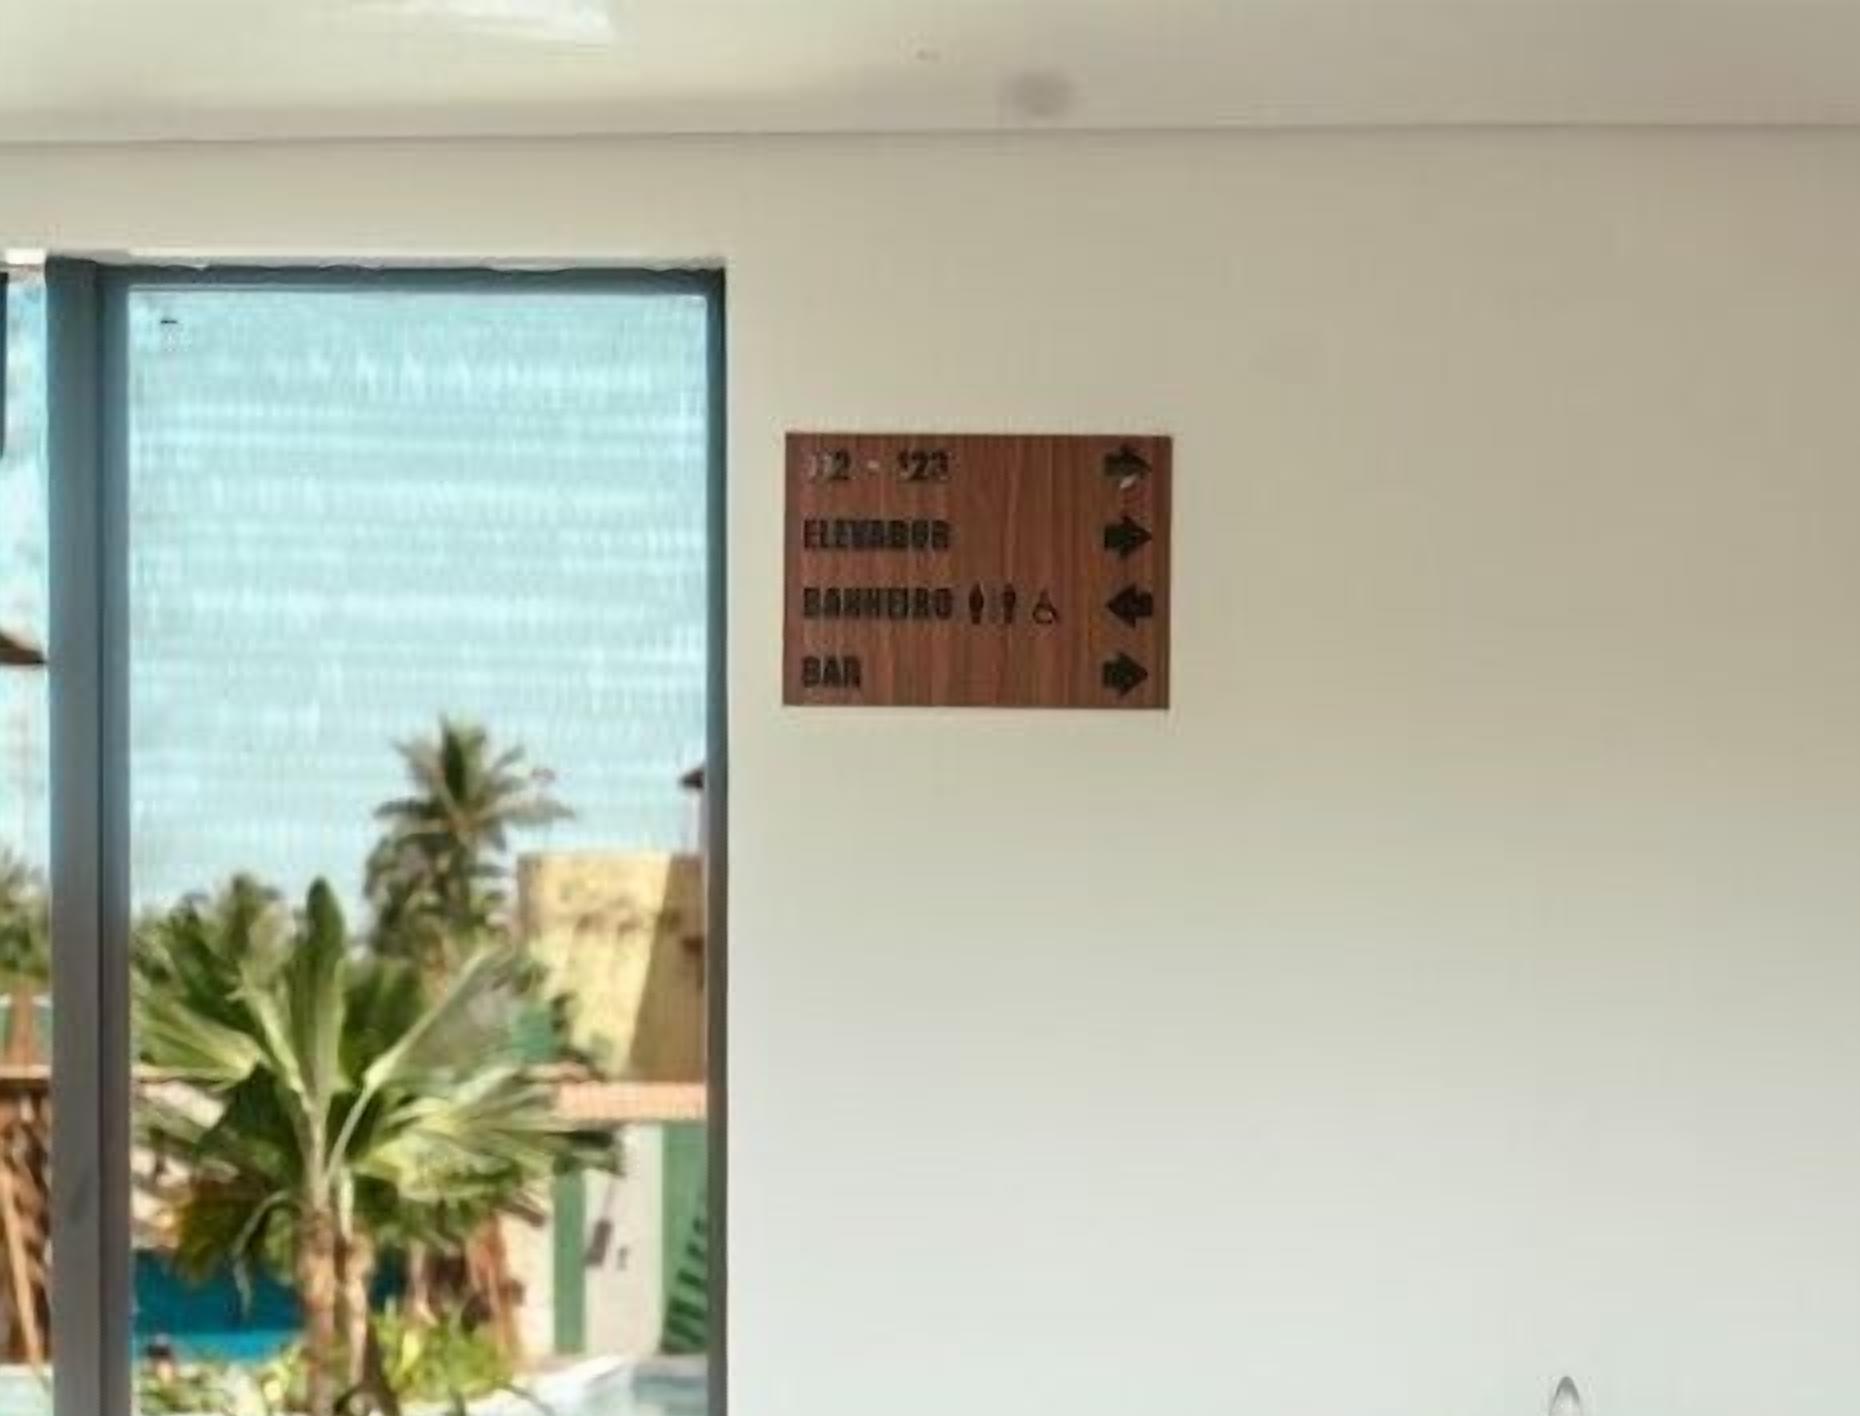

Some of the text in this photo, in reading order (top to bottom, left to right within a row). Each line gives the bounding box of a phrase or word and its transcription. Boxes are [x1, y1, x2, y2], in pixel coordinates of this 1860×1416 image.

[803, 519, 951, 550] ELEVADOR
[803, 586, 953, 619] BANHEIRO
[801, 654, 862, 688] BAR
